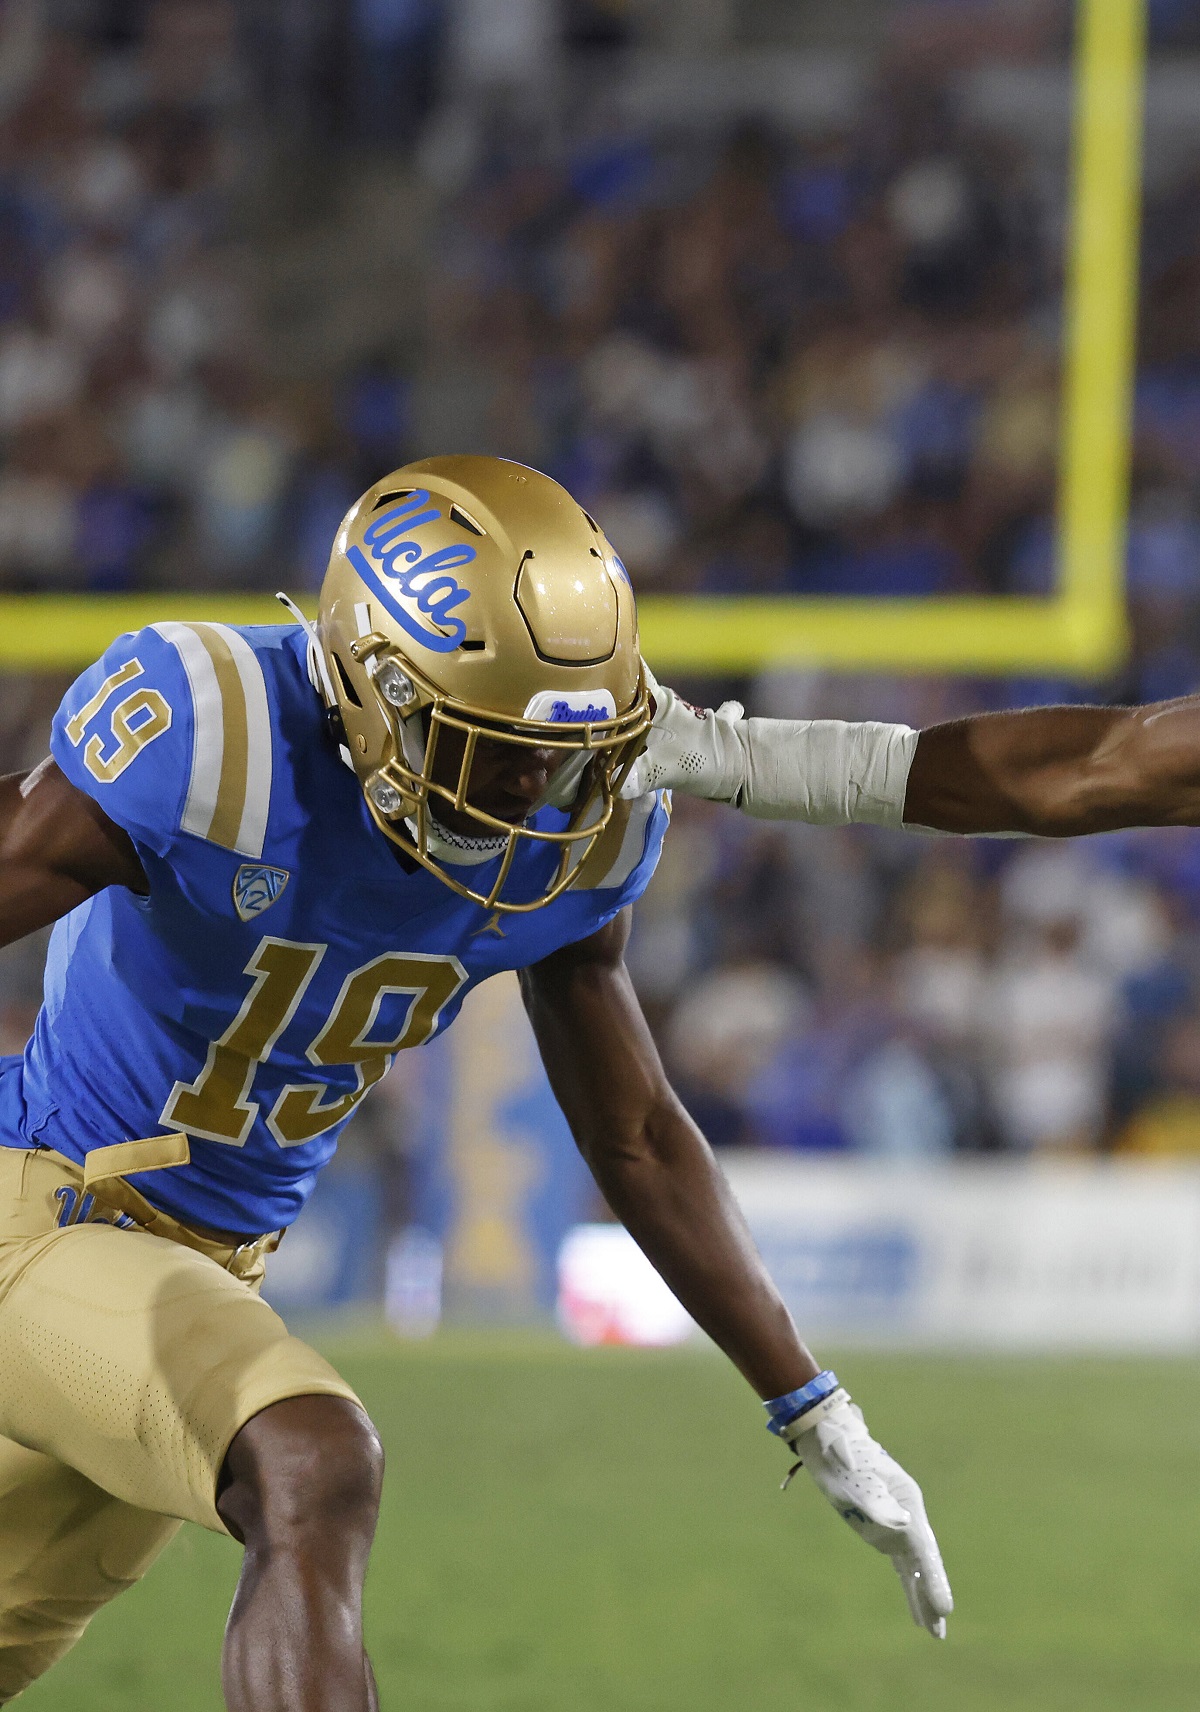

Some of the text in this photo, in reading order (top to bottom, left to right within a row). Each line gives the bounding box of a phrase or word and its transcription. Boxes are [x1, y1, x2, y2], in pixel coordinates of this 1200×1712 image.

[64, 656, 173, 783] 19
[240, 889, 268, 911] 12
[158, 934, 470, 1149] 19
